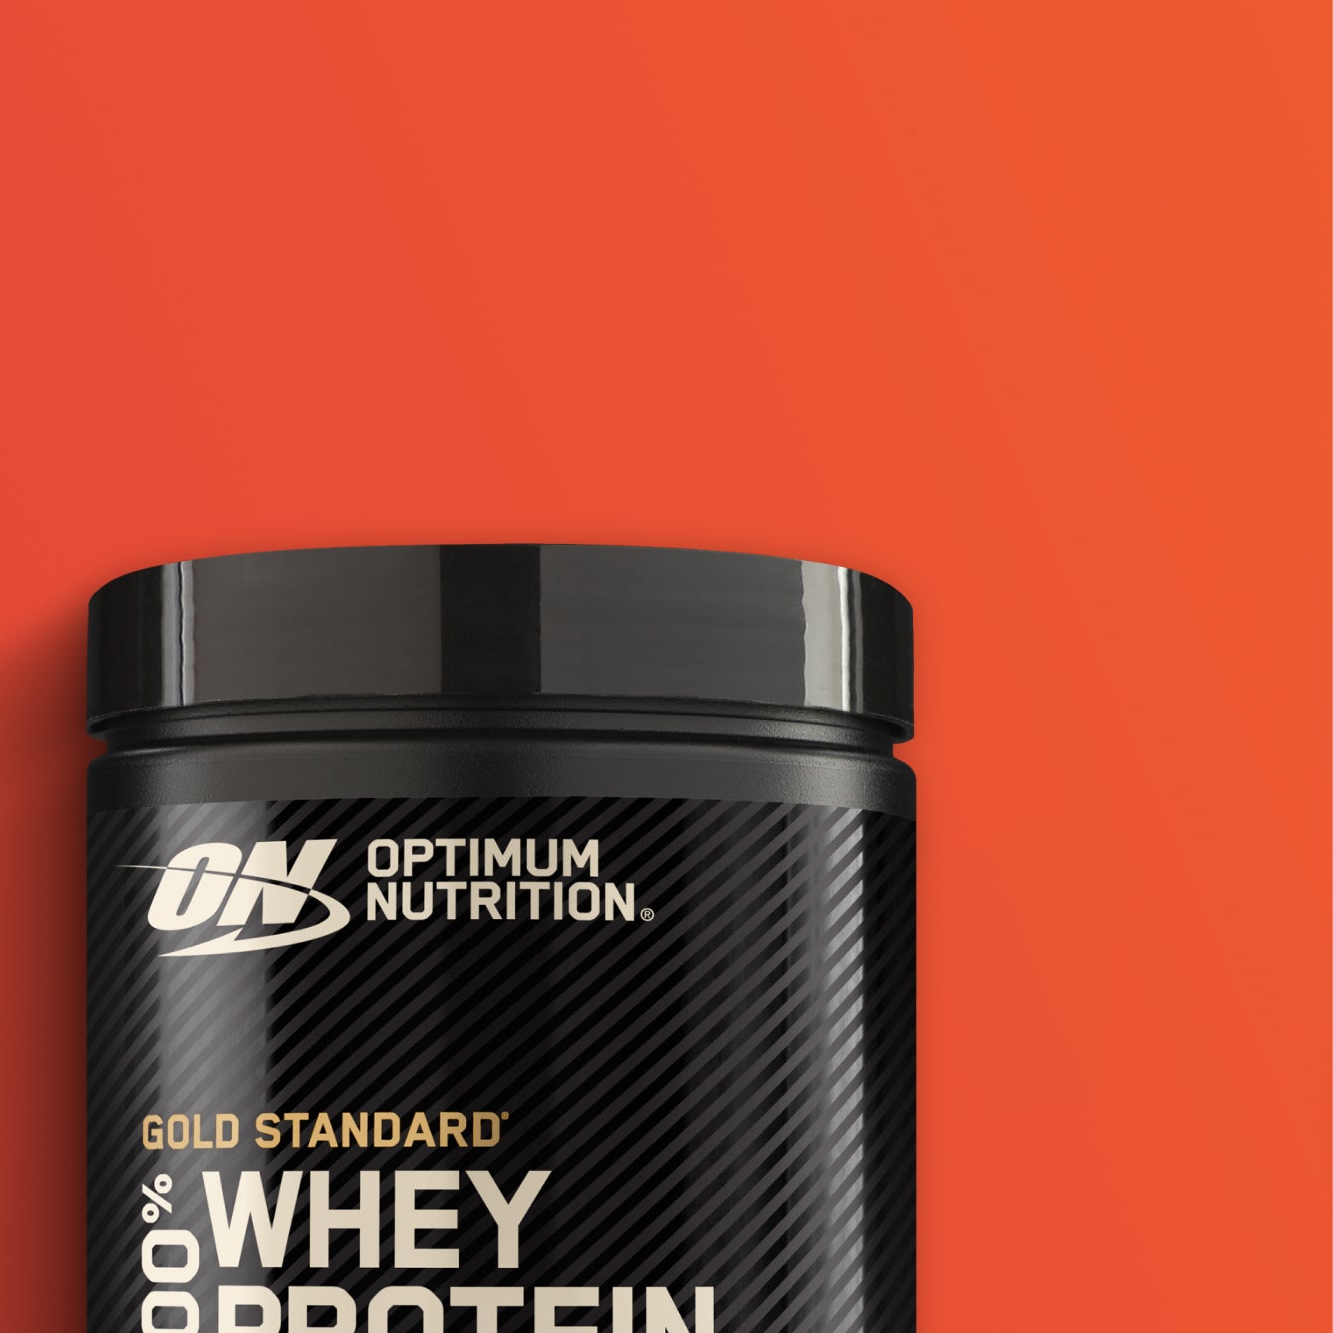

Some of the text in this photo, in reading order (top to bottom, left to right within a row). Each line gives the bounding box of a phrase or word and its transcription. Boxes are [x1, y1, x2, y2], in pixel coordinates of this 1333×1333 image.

[145, 839, 345, 942] ON
[367, 838, 599, 878] OPTIMUM
[142, 1114, 240, 1151] GOLD
[201, 1170, 552, 1269] WHEY
